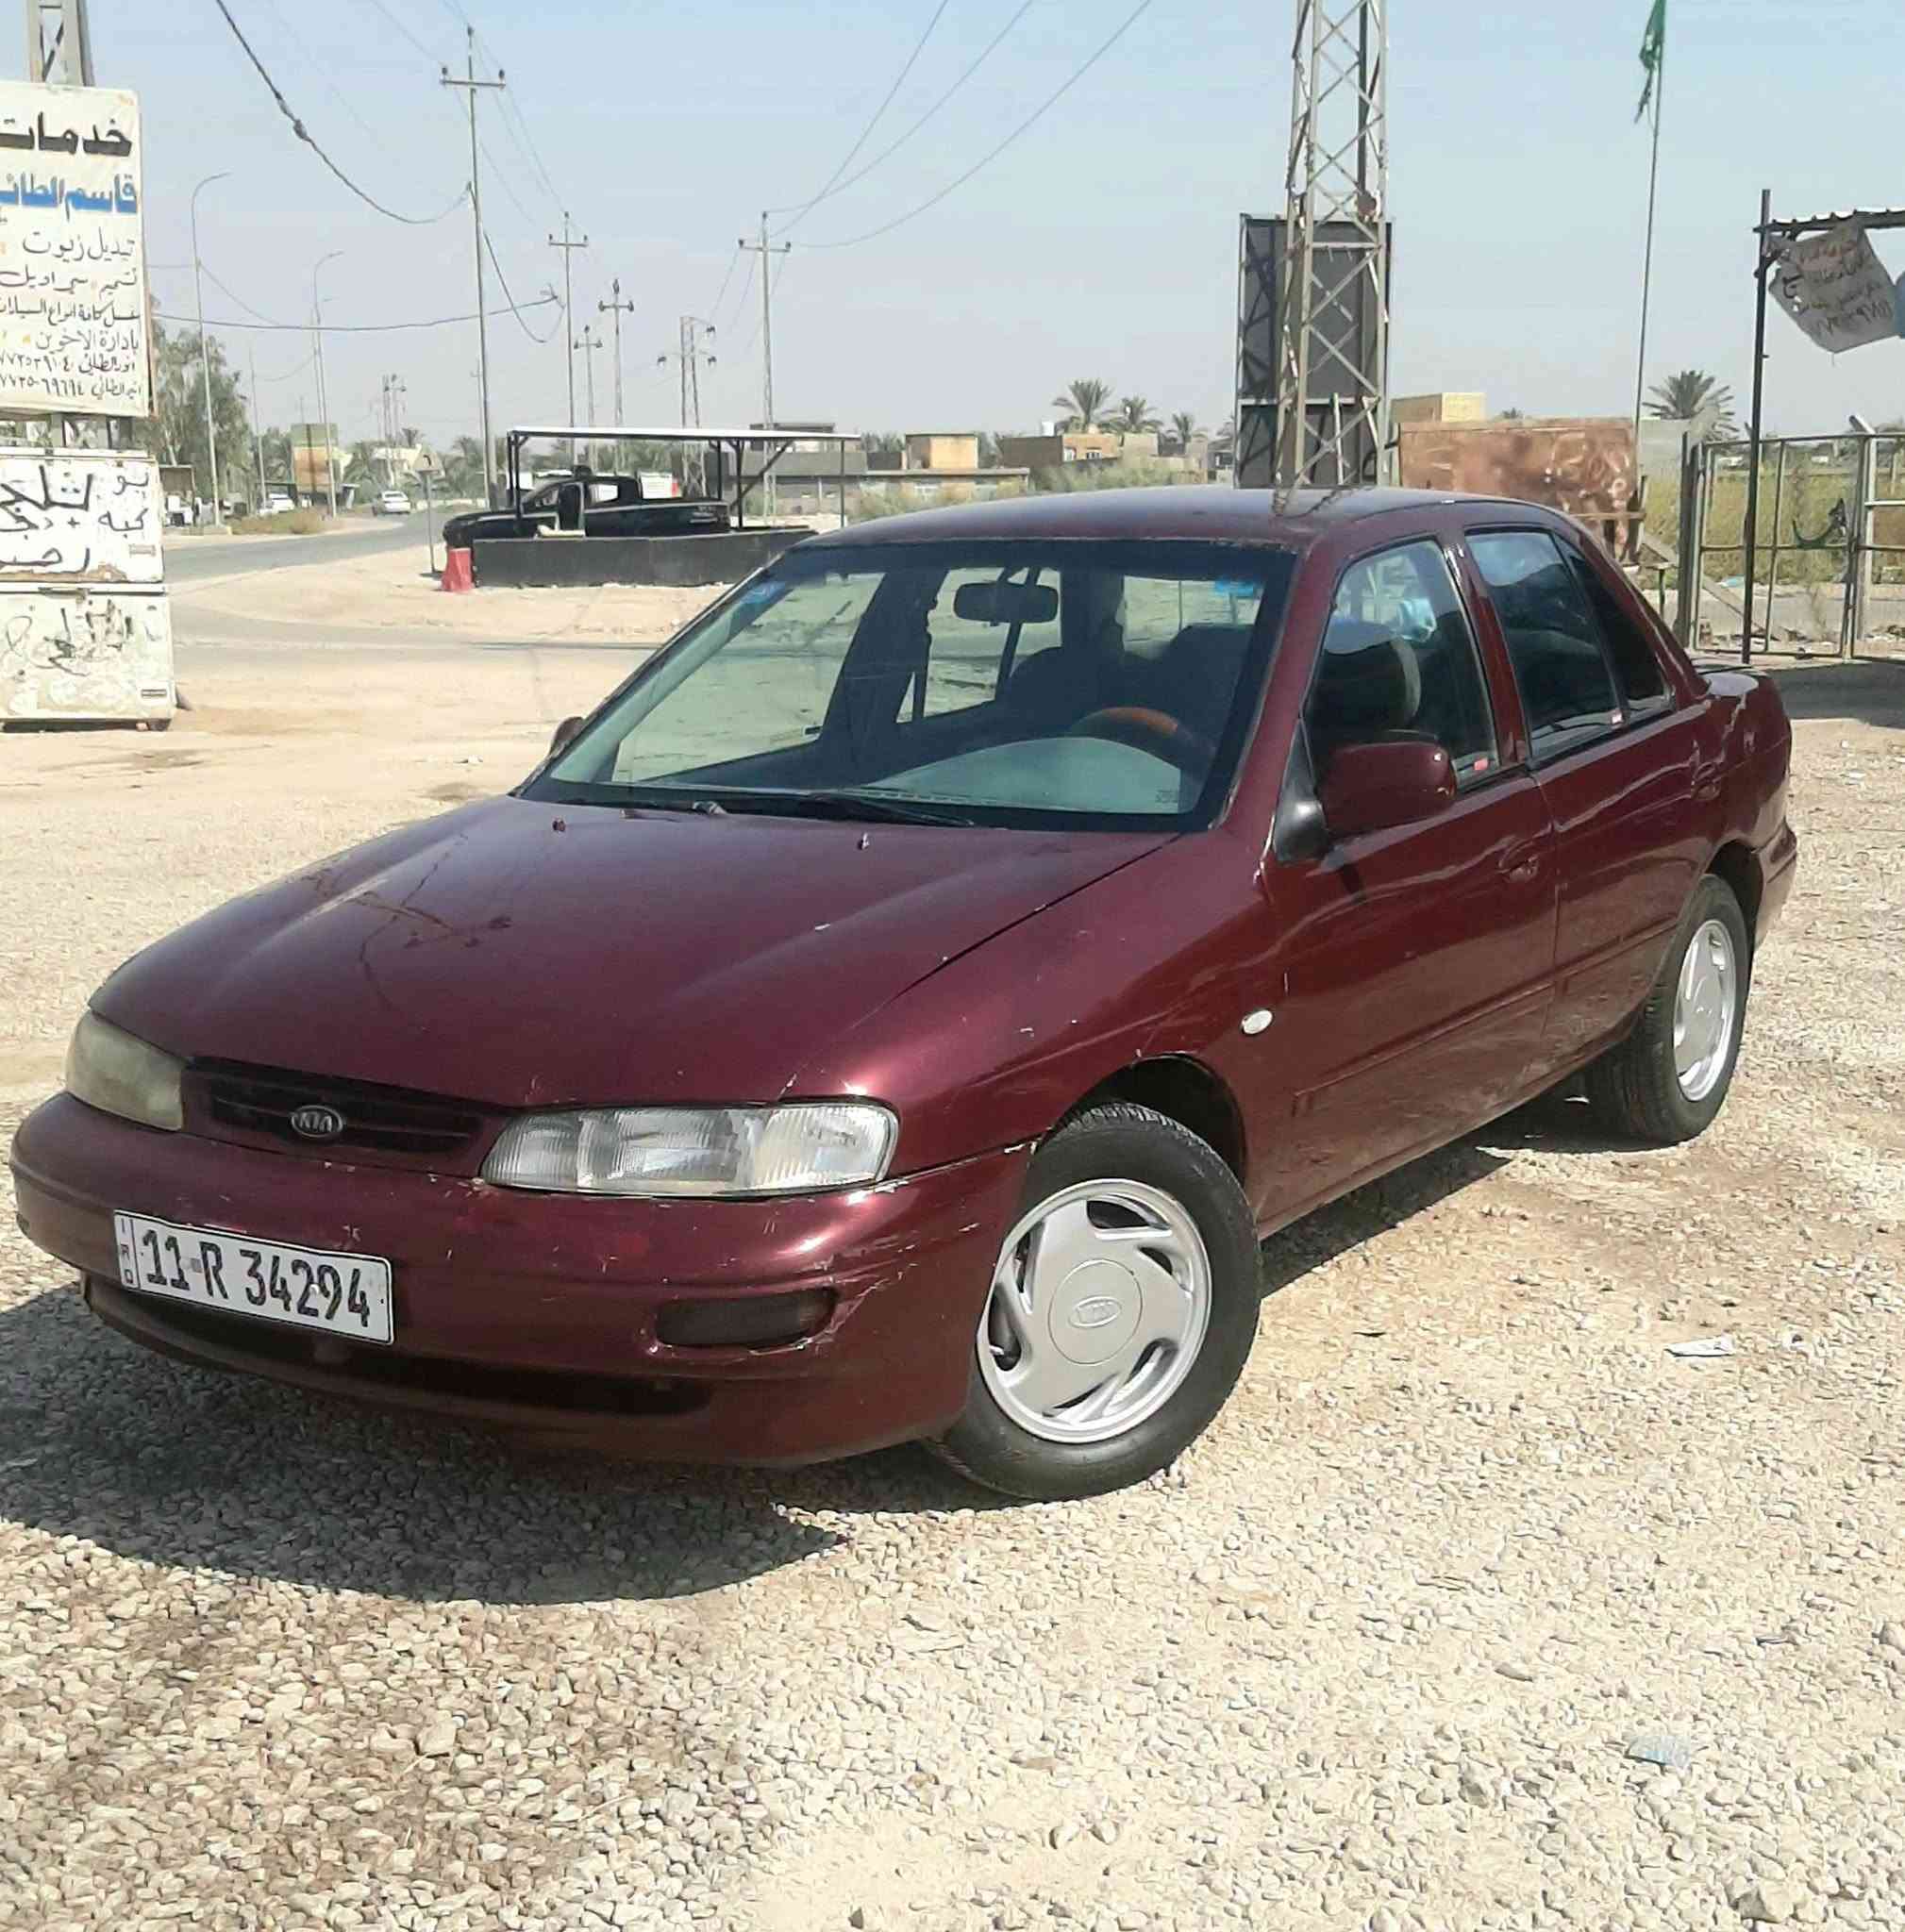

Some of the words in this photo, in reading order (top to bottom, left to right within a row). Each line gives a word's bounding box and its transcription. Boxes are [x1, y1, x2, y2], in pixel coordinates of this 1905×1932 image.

[65, 173, 138, 223] قاسم
[23, 231, 85, 263] زيوت
[239, 1249, 370, 1328] 34294
